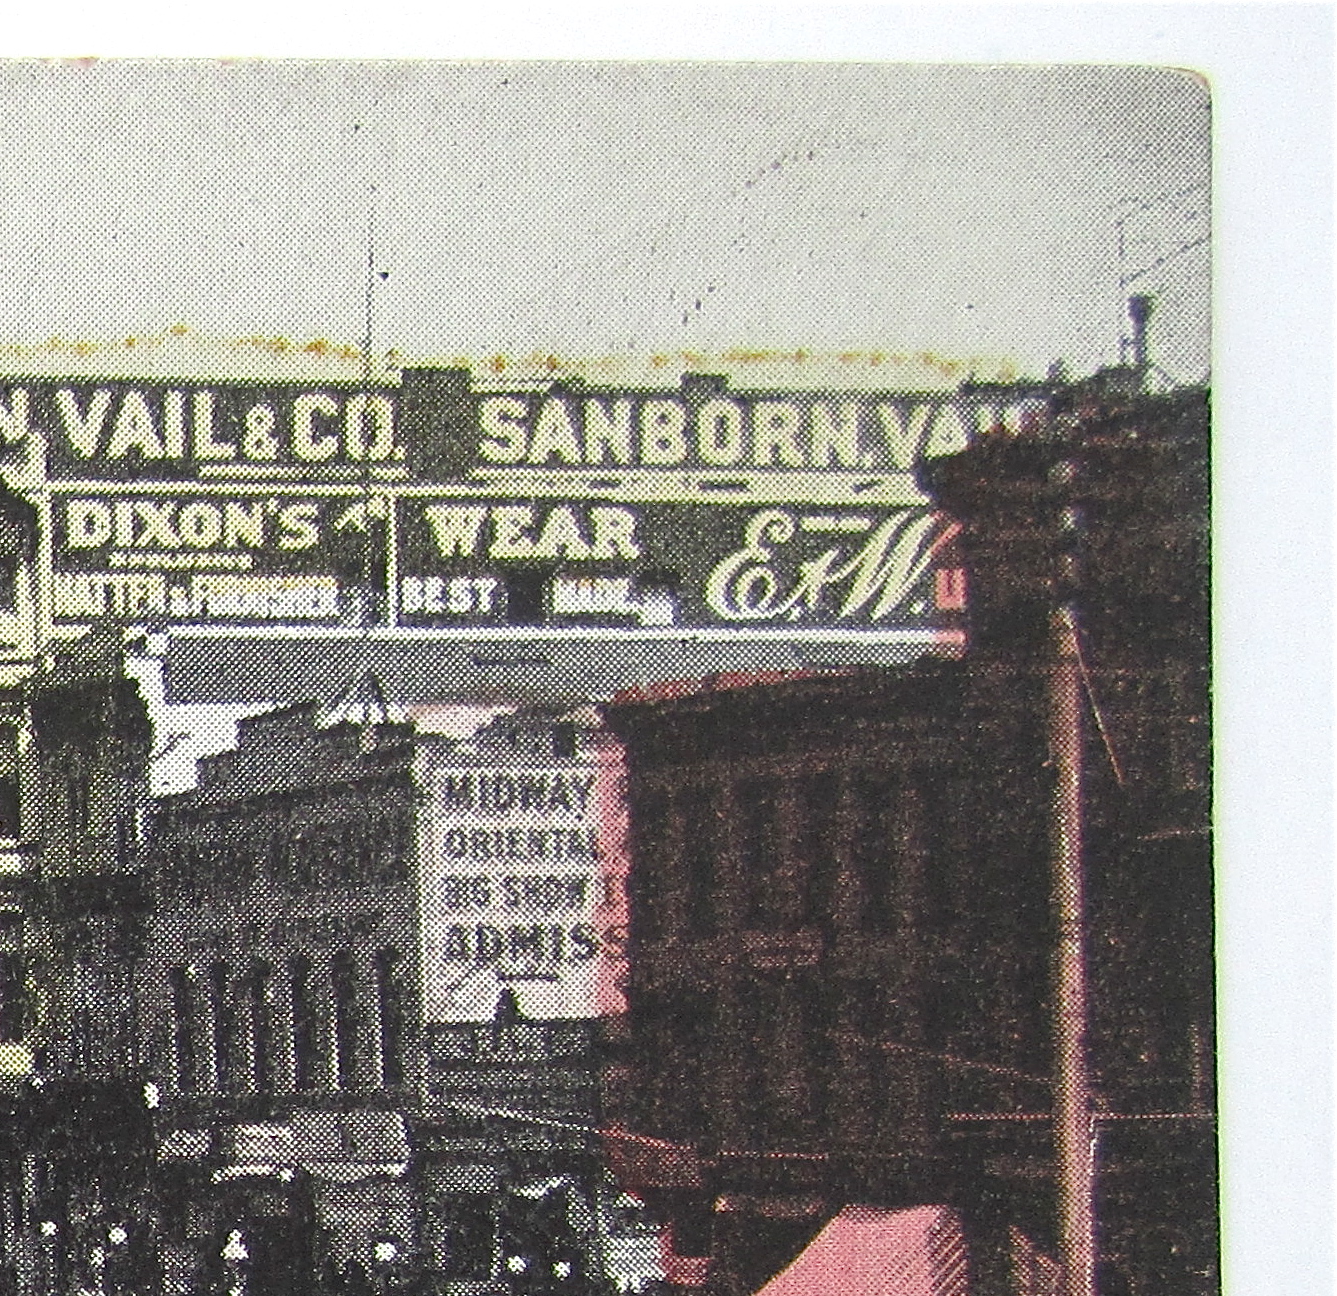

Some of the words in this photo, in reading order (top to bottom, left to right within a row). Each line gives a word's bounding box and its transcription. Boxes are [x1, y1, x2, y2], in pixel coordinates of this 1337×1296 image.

[66, 497, 321, 550] DIXON'S
[426, 505, 642, 560] WEAR
[400, 574, 498, 614] BEST
[443, 772, 595, 813] MIDWAY
[502, 874, 589, 909] SHOW
